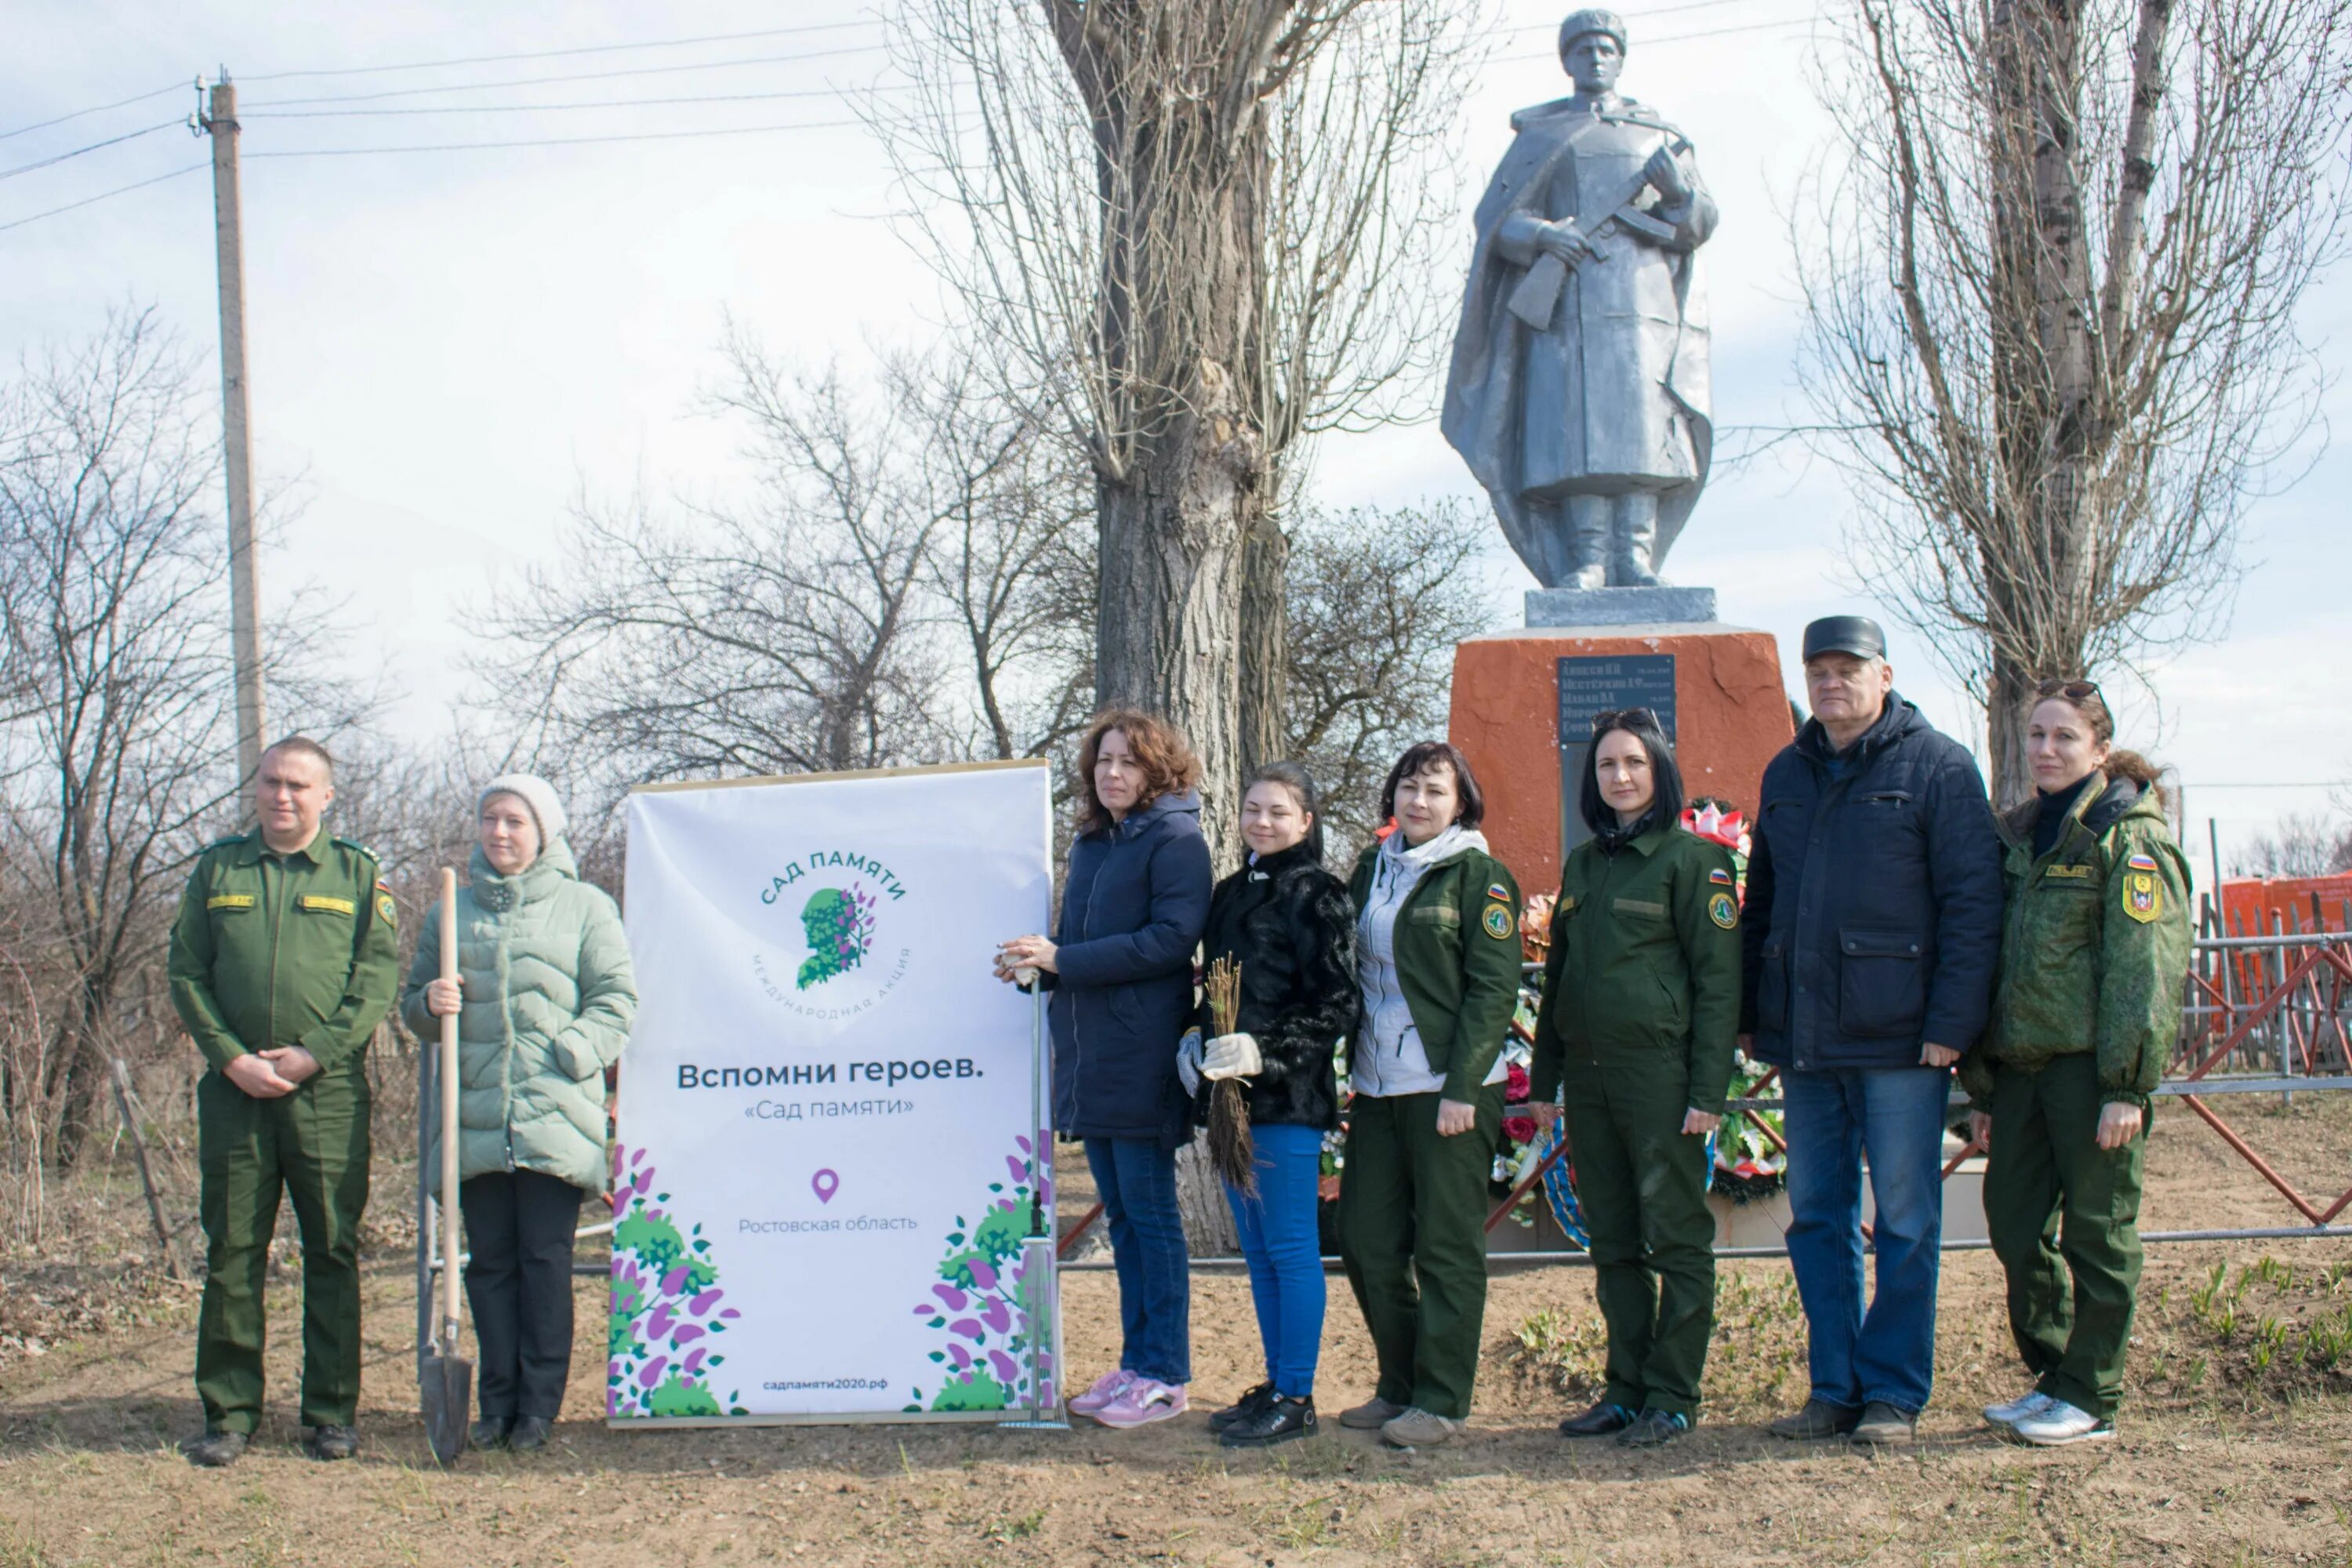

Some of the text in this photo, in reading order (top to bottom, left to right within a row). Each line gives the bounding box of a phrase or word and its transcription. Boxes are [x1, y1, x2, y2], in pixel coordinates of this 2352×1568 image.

[760, 850, 907, 906] САД ПАМЯТИ
[752, 946, 912, 1022] МЕЖДУНАРОДНАЯ АКЦИЯ
[677, 1058, 985, 1090] Вспомни героев.
[744, 1097, 915, 1122] «Сад памяти»
[738, 1214, 919, 1235] Ростовская область
[763, 1377, 888, 1392] садпамяти2020.рф
